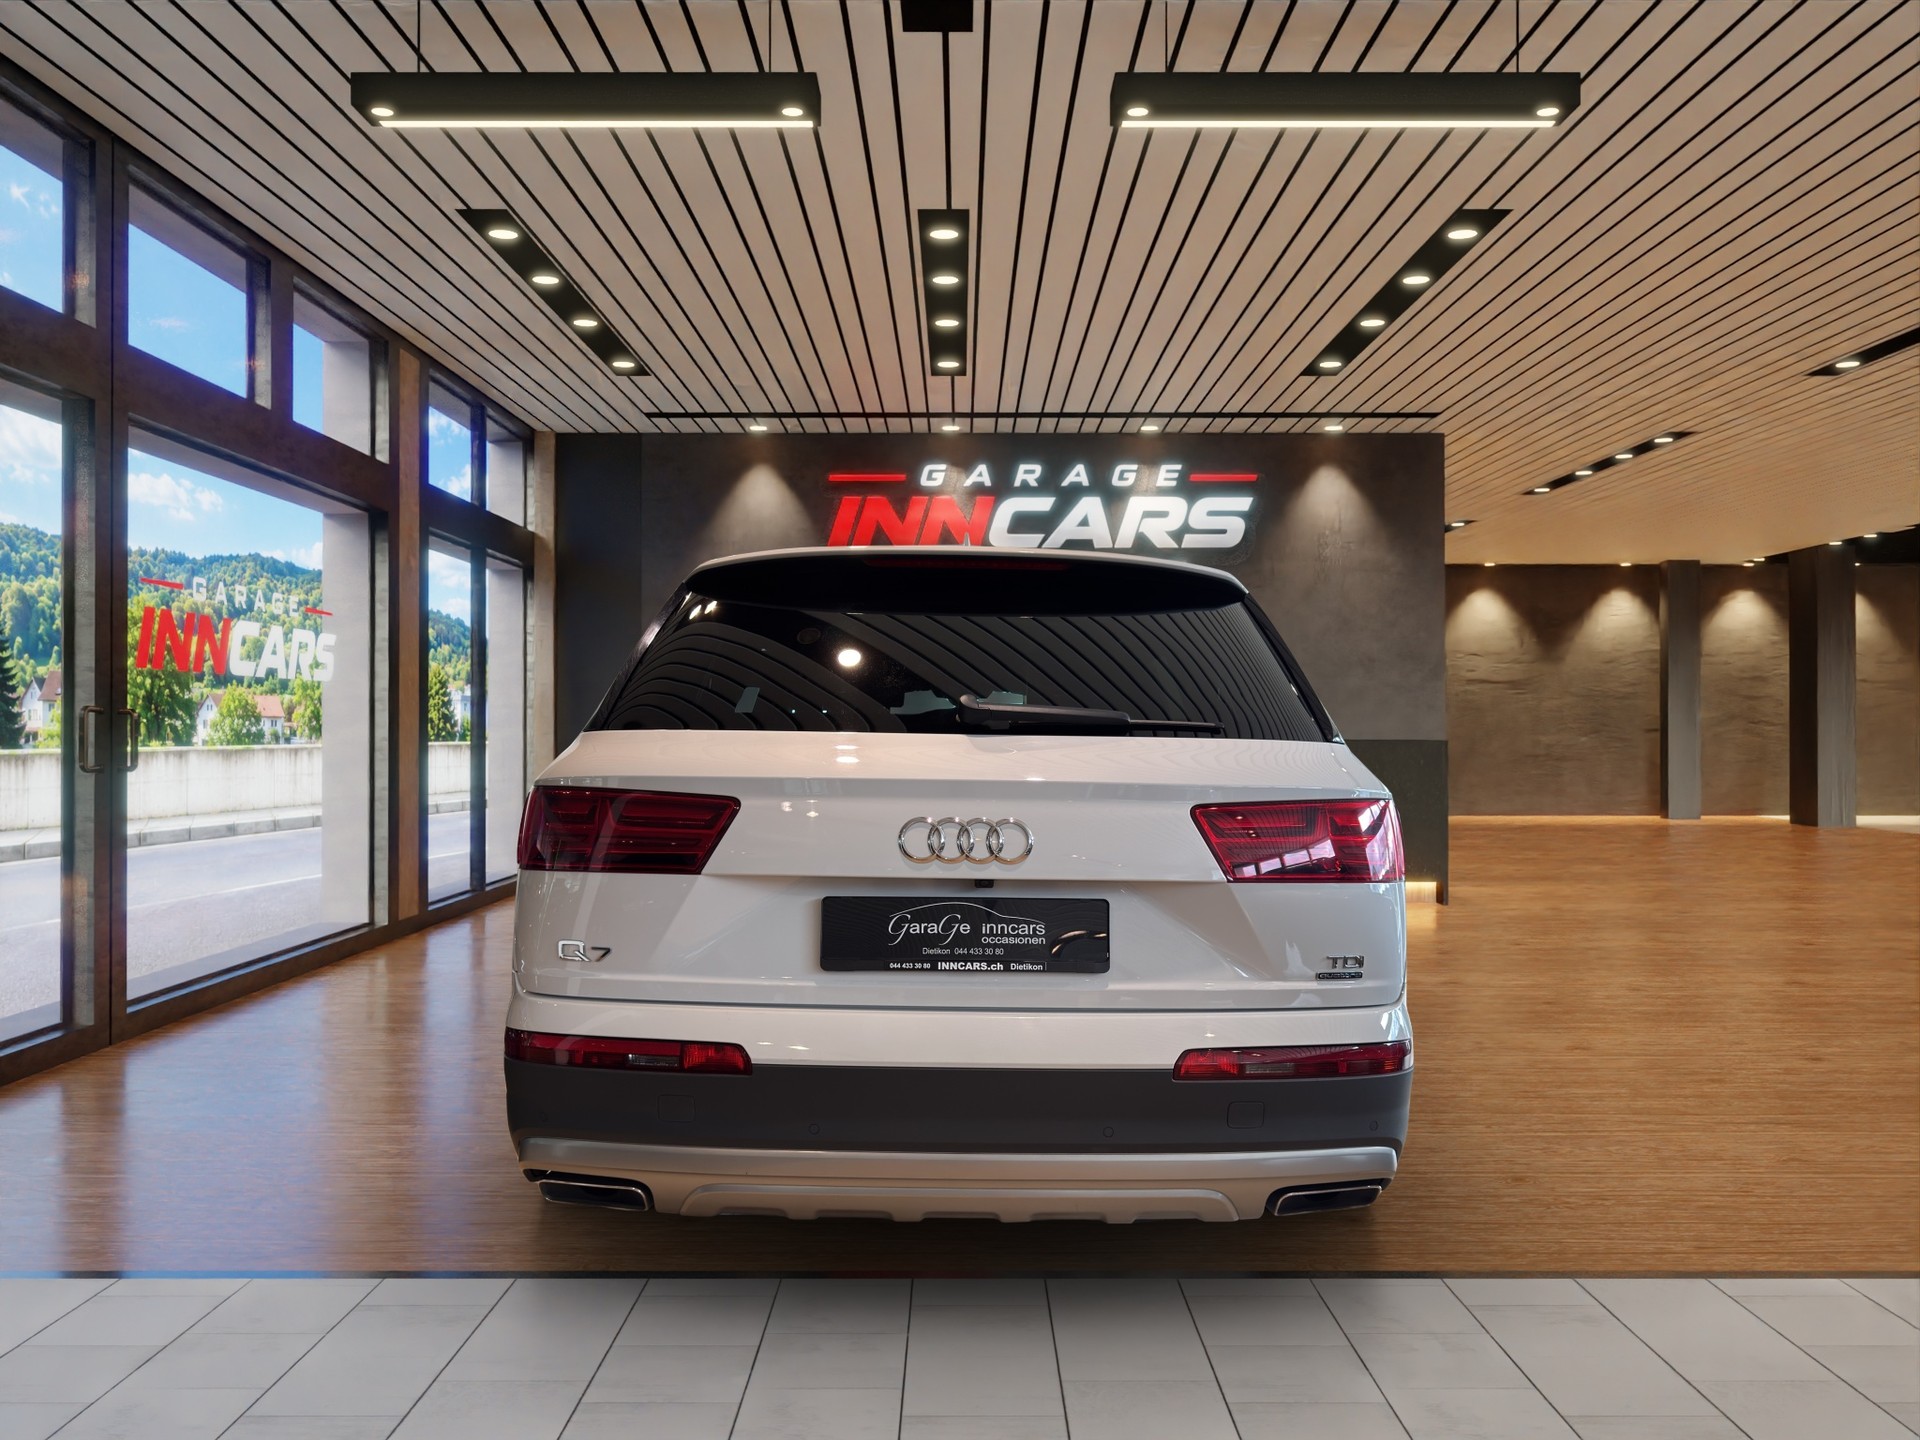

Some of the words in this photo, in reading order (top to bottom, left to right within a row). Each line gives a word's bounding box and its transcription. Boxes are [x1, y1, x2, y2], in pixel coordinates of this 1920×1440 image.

[919, 463, 1183, 487] GARAGE
[827, 496, 1254, 549] INNCARS
[192, 576, 300, 617] GARAGE
[135, 606, 337, 682] INNCARS
[981, 923, 1046, 935] inncars
[981, 936, 1046, 945] occasionen
[558, 940, 611, 962] Q7
[922, 947, 951, 955] Dietikon
[954, 947, 968, 955] 044
[969, 947, 983, 955] 433
[984, 947, 994, 955] 30
[995, 947, 1004, 955] 80
[938, 961, 1004, 971] INNCARS.ch
[1010, 963, 1043, 971] Dietikon
[1326, 955, 1364, 969] TDI
